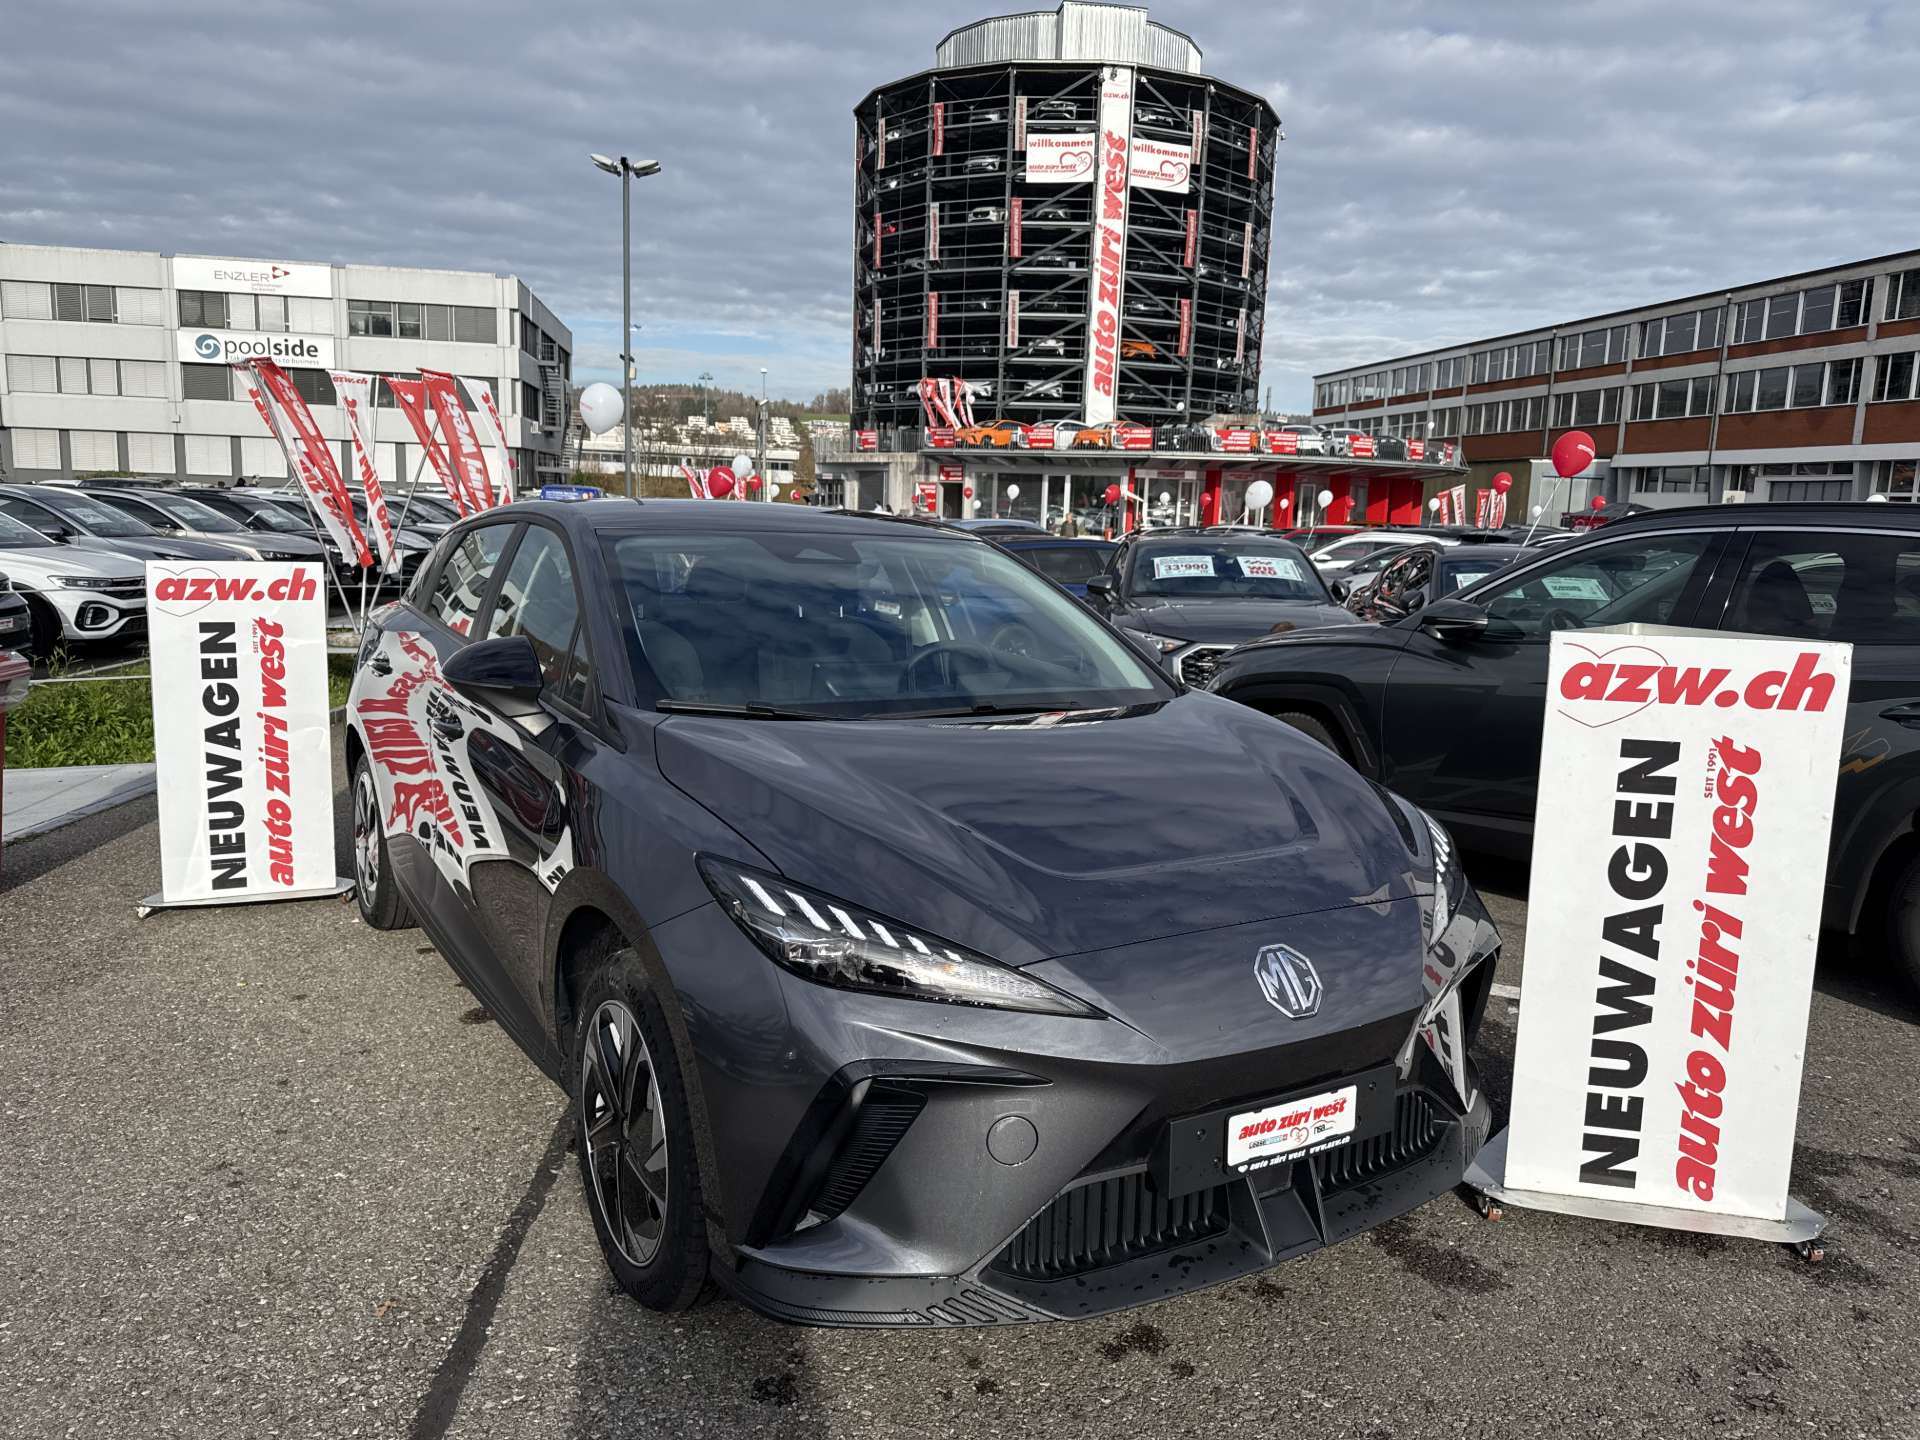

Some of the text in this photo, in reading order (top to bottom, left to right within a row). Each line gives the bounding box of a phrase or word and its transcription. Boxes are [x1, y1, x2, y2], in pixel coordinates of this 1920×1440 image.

[1028, 138, 1093, 148] willkommen
[1133, 143, 1189, 159] willkommen
[213, 270, 270, 283] ENZLER
[1093, 128, 1127, 397] auto züri west
[224, 337, 319, 363] poolside
[332, 375, 369, 385] azw.ch
[440, 390, 478, 453] west
[155, 568, 317, 601] azw.ch
[1164, 563, 1209, 571] 33'990
[1560, 653, 1835, 713] azw.ch
[199, 621, 248, 891] NEUWAGEN
[253, 616, 294, 887] auto züri west
[1704, 746, 1718, 799] SEIT 1991
[1260, 951, 1317, 1010] MG
[1579, 738, 1681, 1190] NEUWAGEN
[1673, 735, 1763, 1203] auto züri west
[1238, 1118, 1277, 1140] auto
[1277, 1107, 1312, 1131] züri
[1313, 1097, 1347, 1120] west
[1249, 1136, 1351, 1171] auto züri west www.azw.ch
